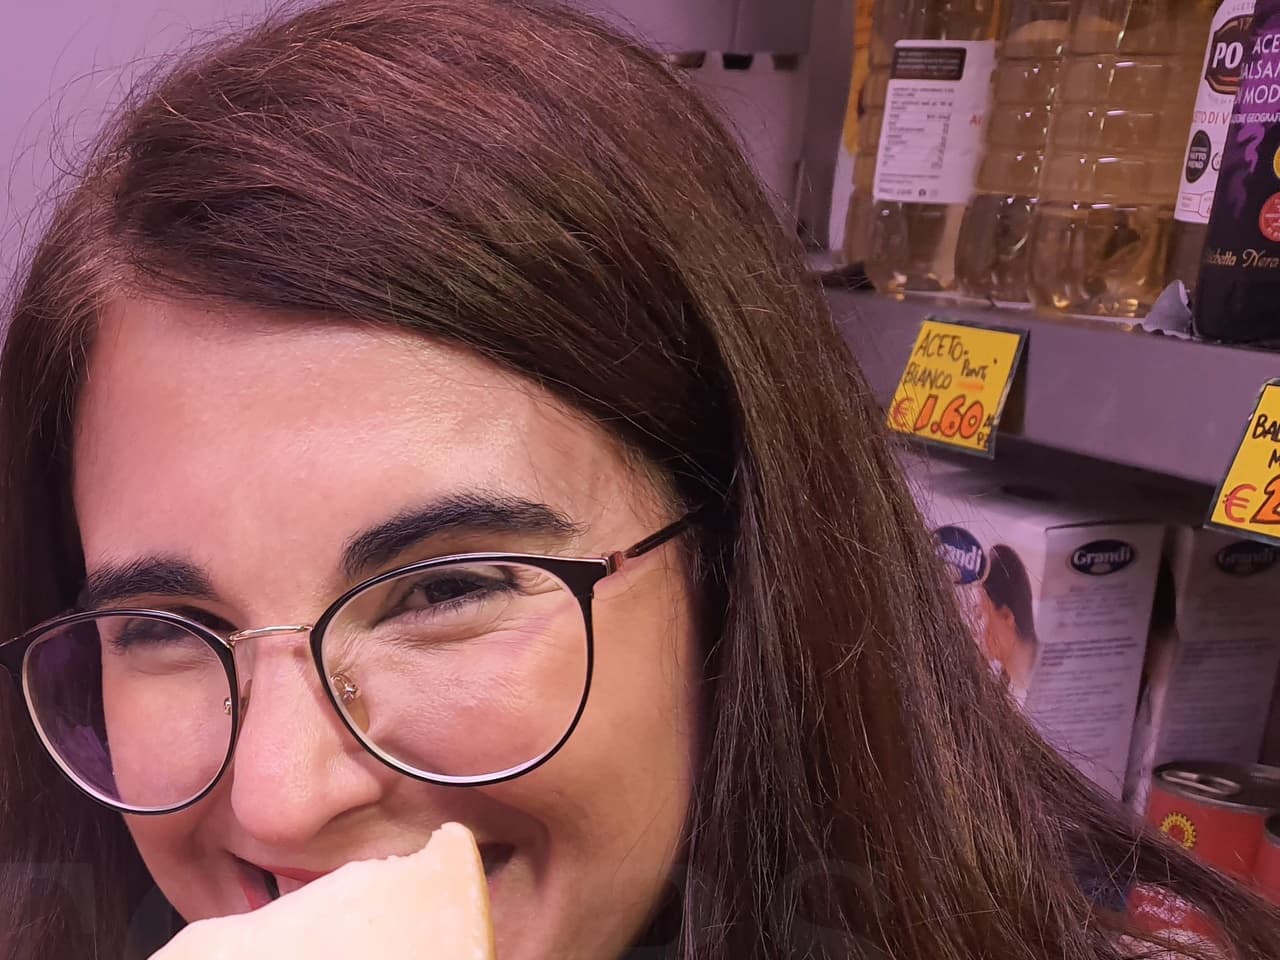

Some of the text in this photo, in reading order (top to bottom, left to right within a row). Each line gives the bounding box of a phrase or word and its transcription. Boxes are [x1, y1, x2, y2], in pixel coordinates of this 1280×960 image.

[914, 329, 963, 362] ACETO
[902, 361, 953, 391] BIANCO
[1072, 545, 1131, 566] Grandi
